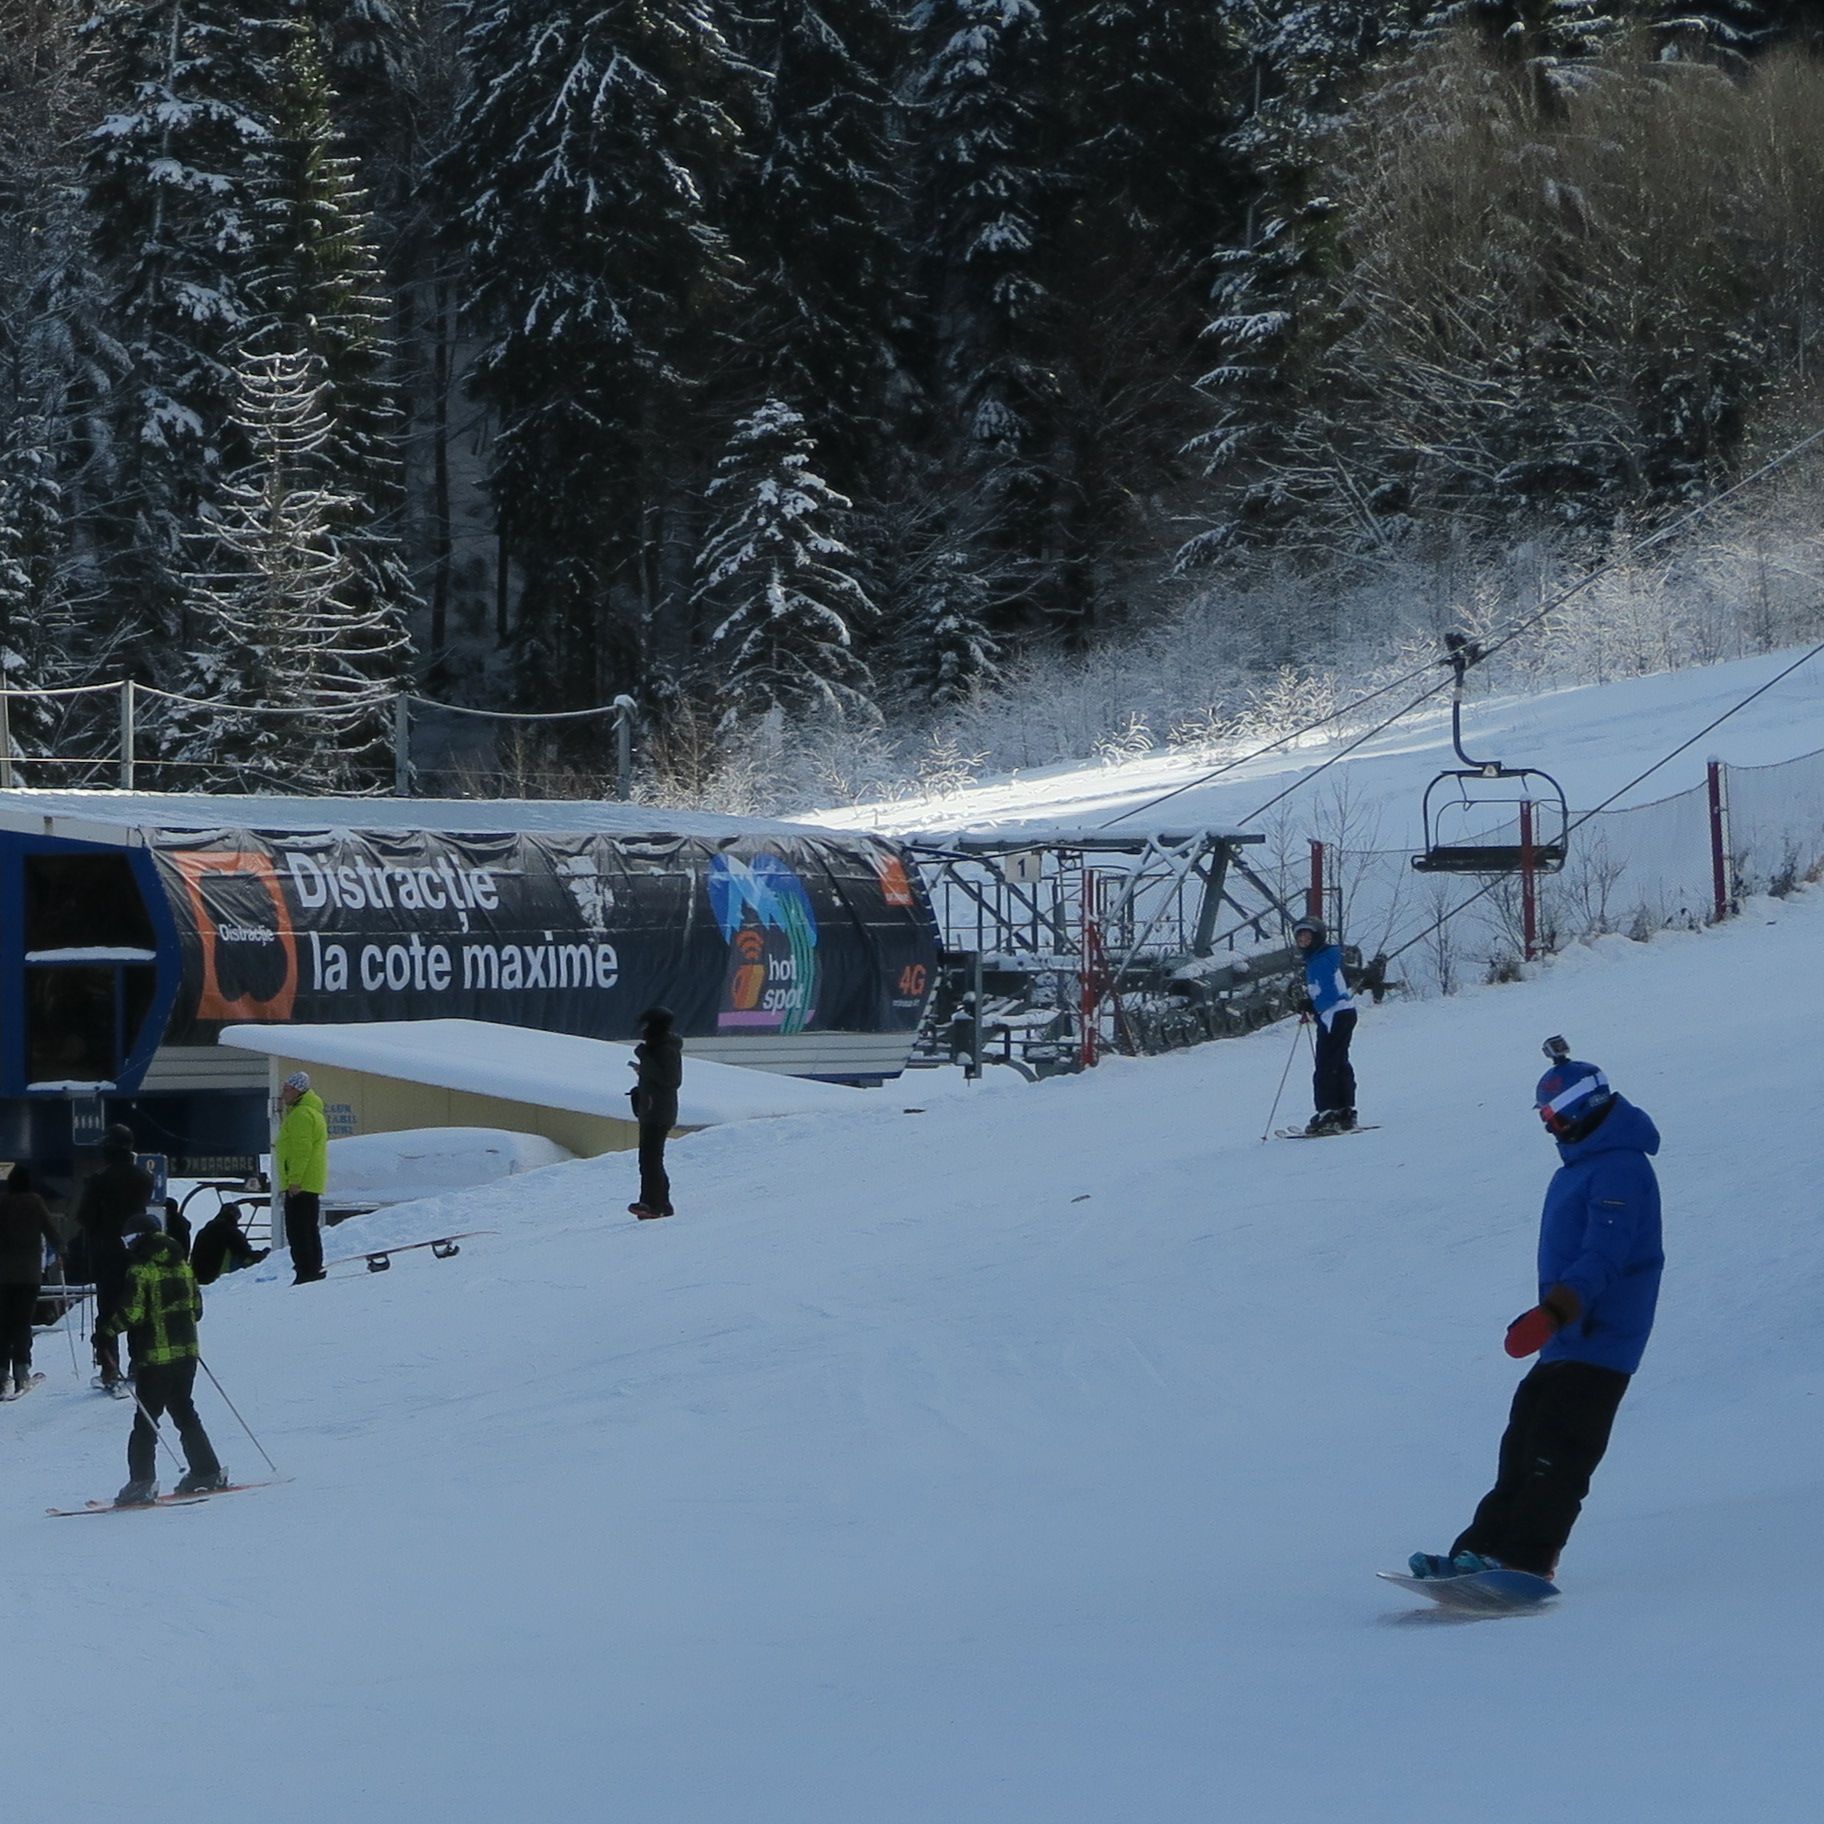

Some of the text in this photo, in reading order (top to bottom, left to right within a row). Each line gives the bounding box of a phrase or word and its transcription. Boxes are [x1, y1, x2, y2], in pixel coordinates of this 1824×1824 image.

[1015, 859, 1027, 878] 1
[313, 930, 619, 991] la cote maxime
[768, 954, 798, 982] hot
[899, 964, 927, 995] 4G
[762, 982, 804, 1015] spot
